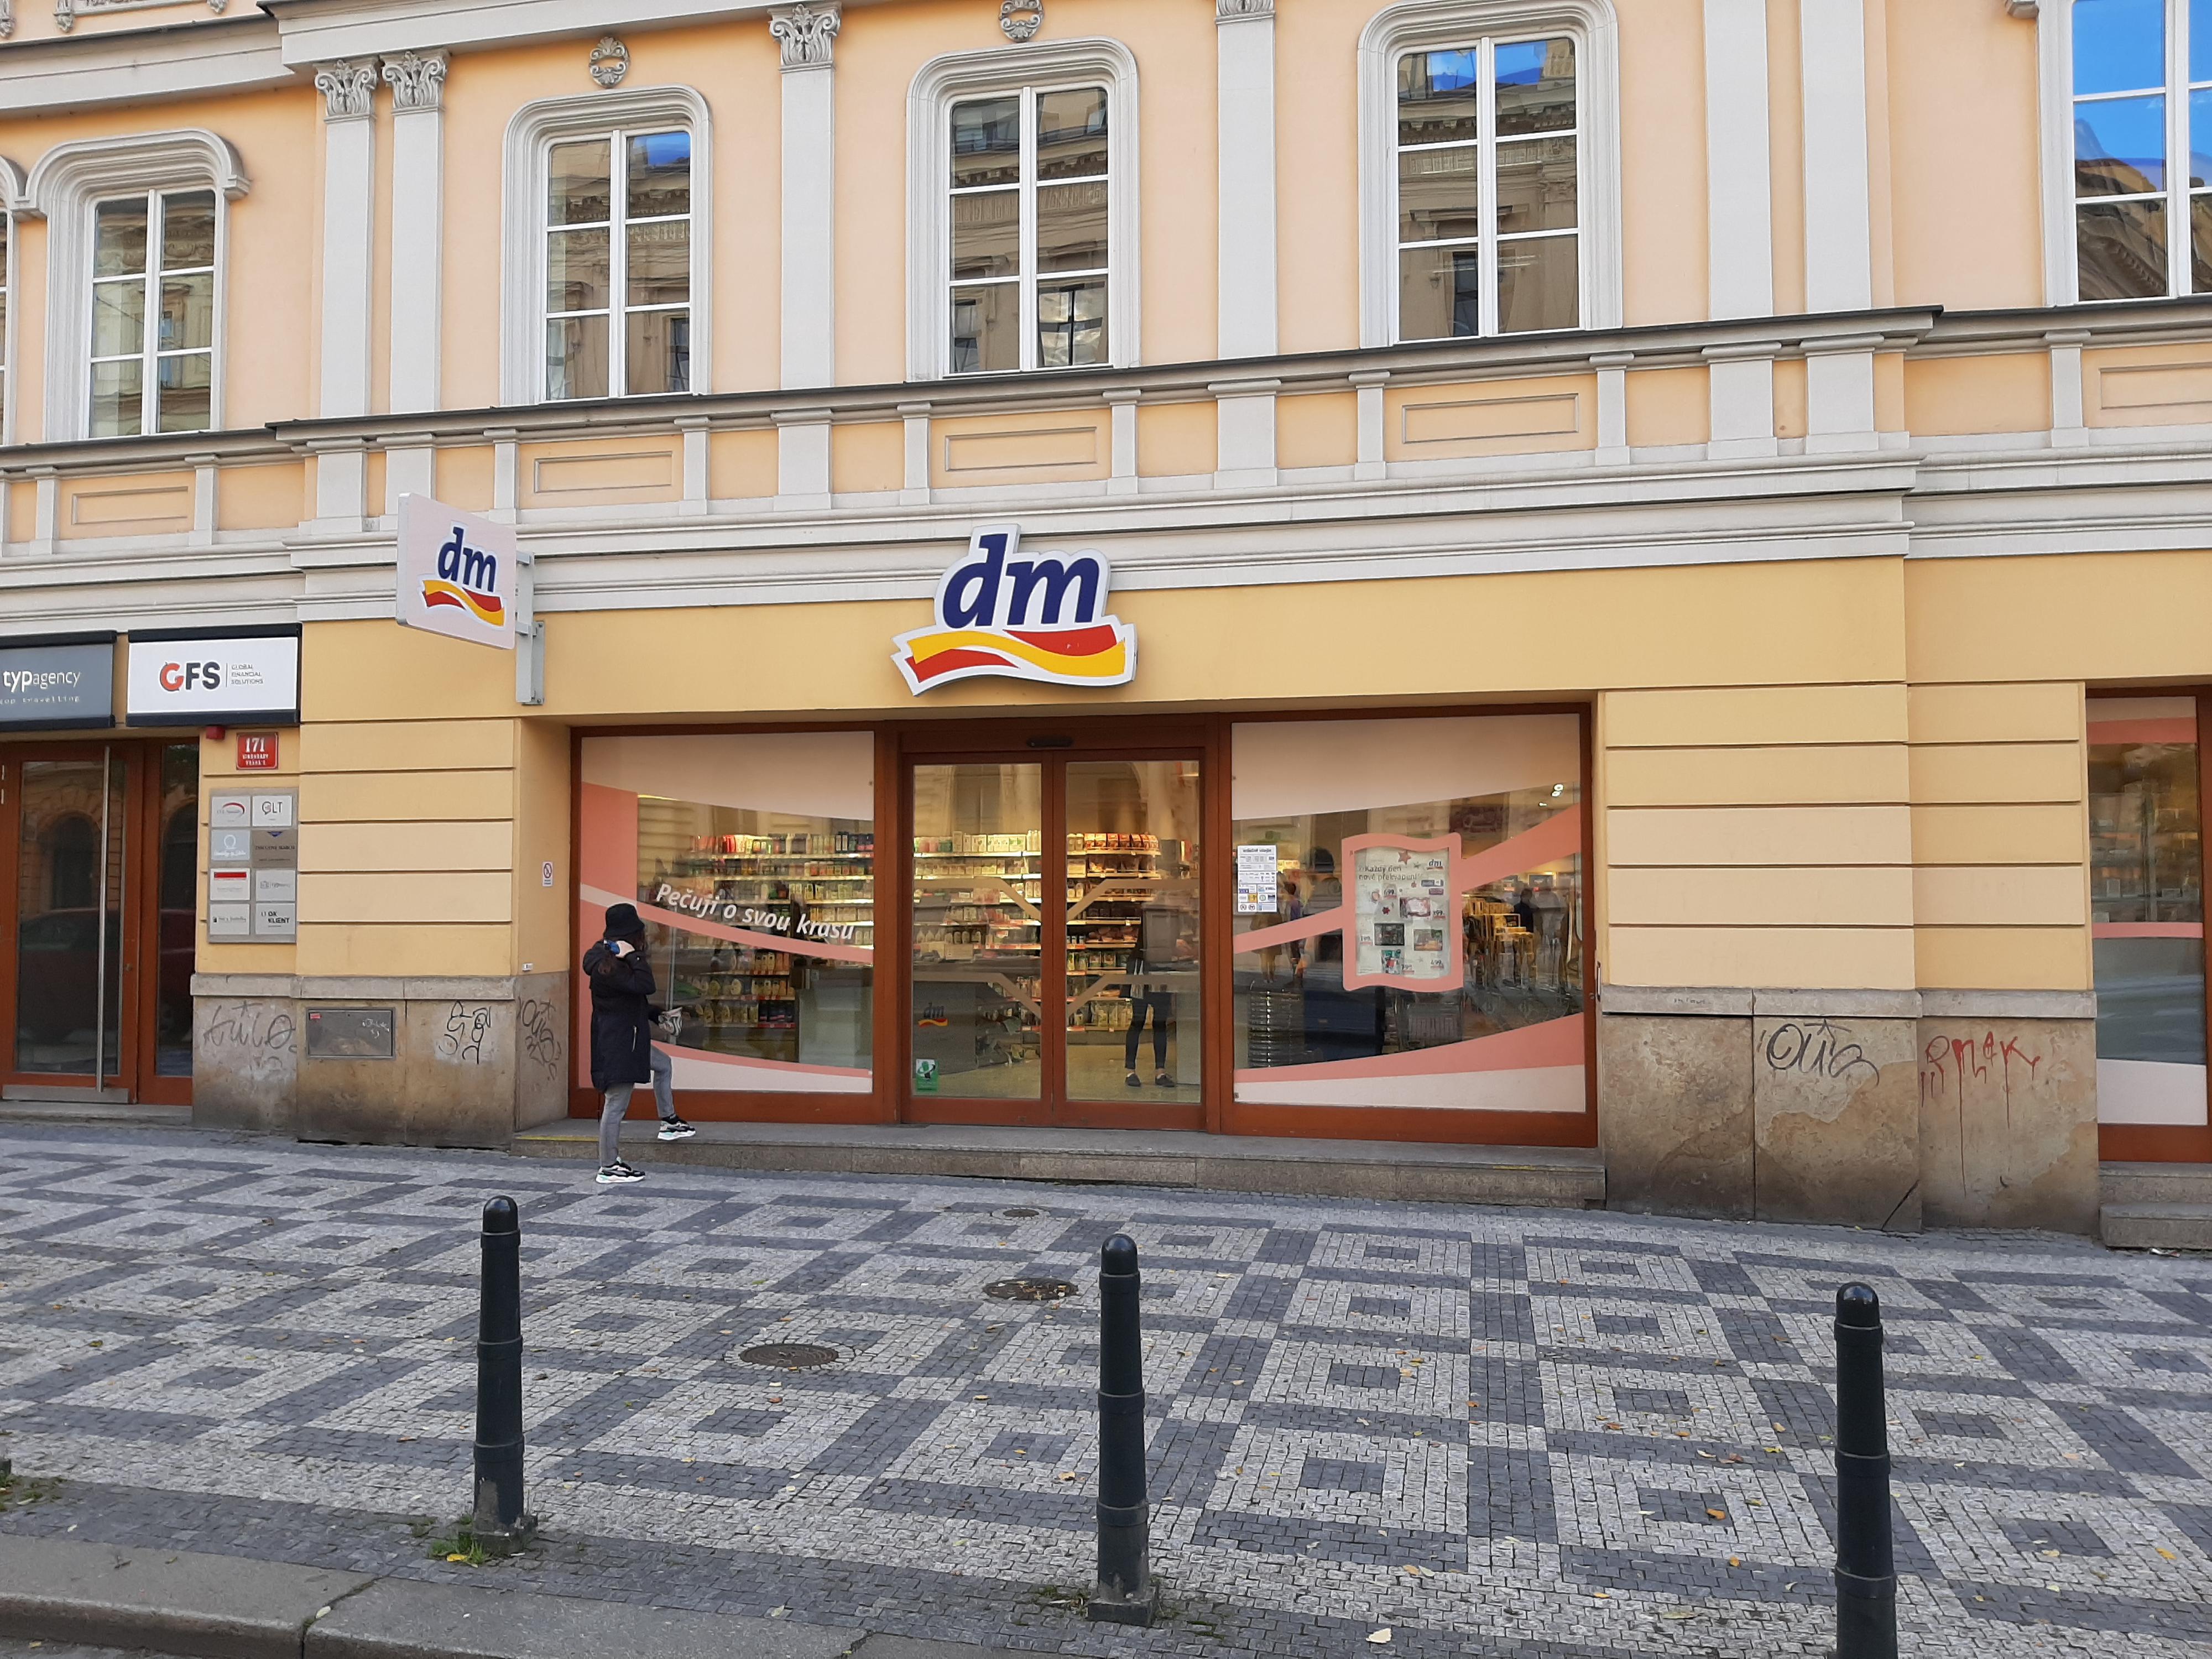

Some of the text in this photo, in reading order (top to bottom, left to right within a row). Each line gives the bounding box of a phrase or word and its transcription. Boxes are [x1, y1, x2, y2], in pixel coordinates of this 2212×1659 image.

[437, 526, 496, 592] dm
[943, 534, 1099, 629] dm
[160, 662, 220, 691] GFS
[246, 738, 265, 753] 171
[723, 904, 737, 919] o
[742, 908, 791, 931] svou
